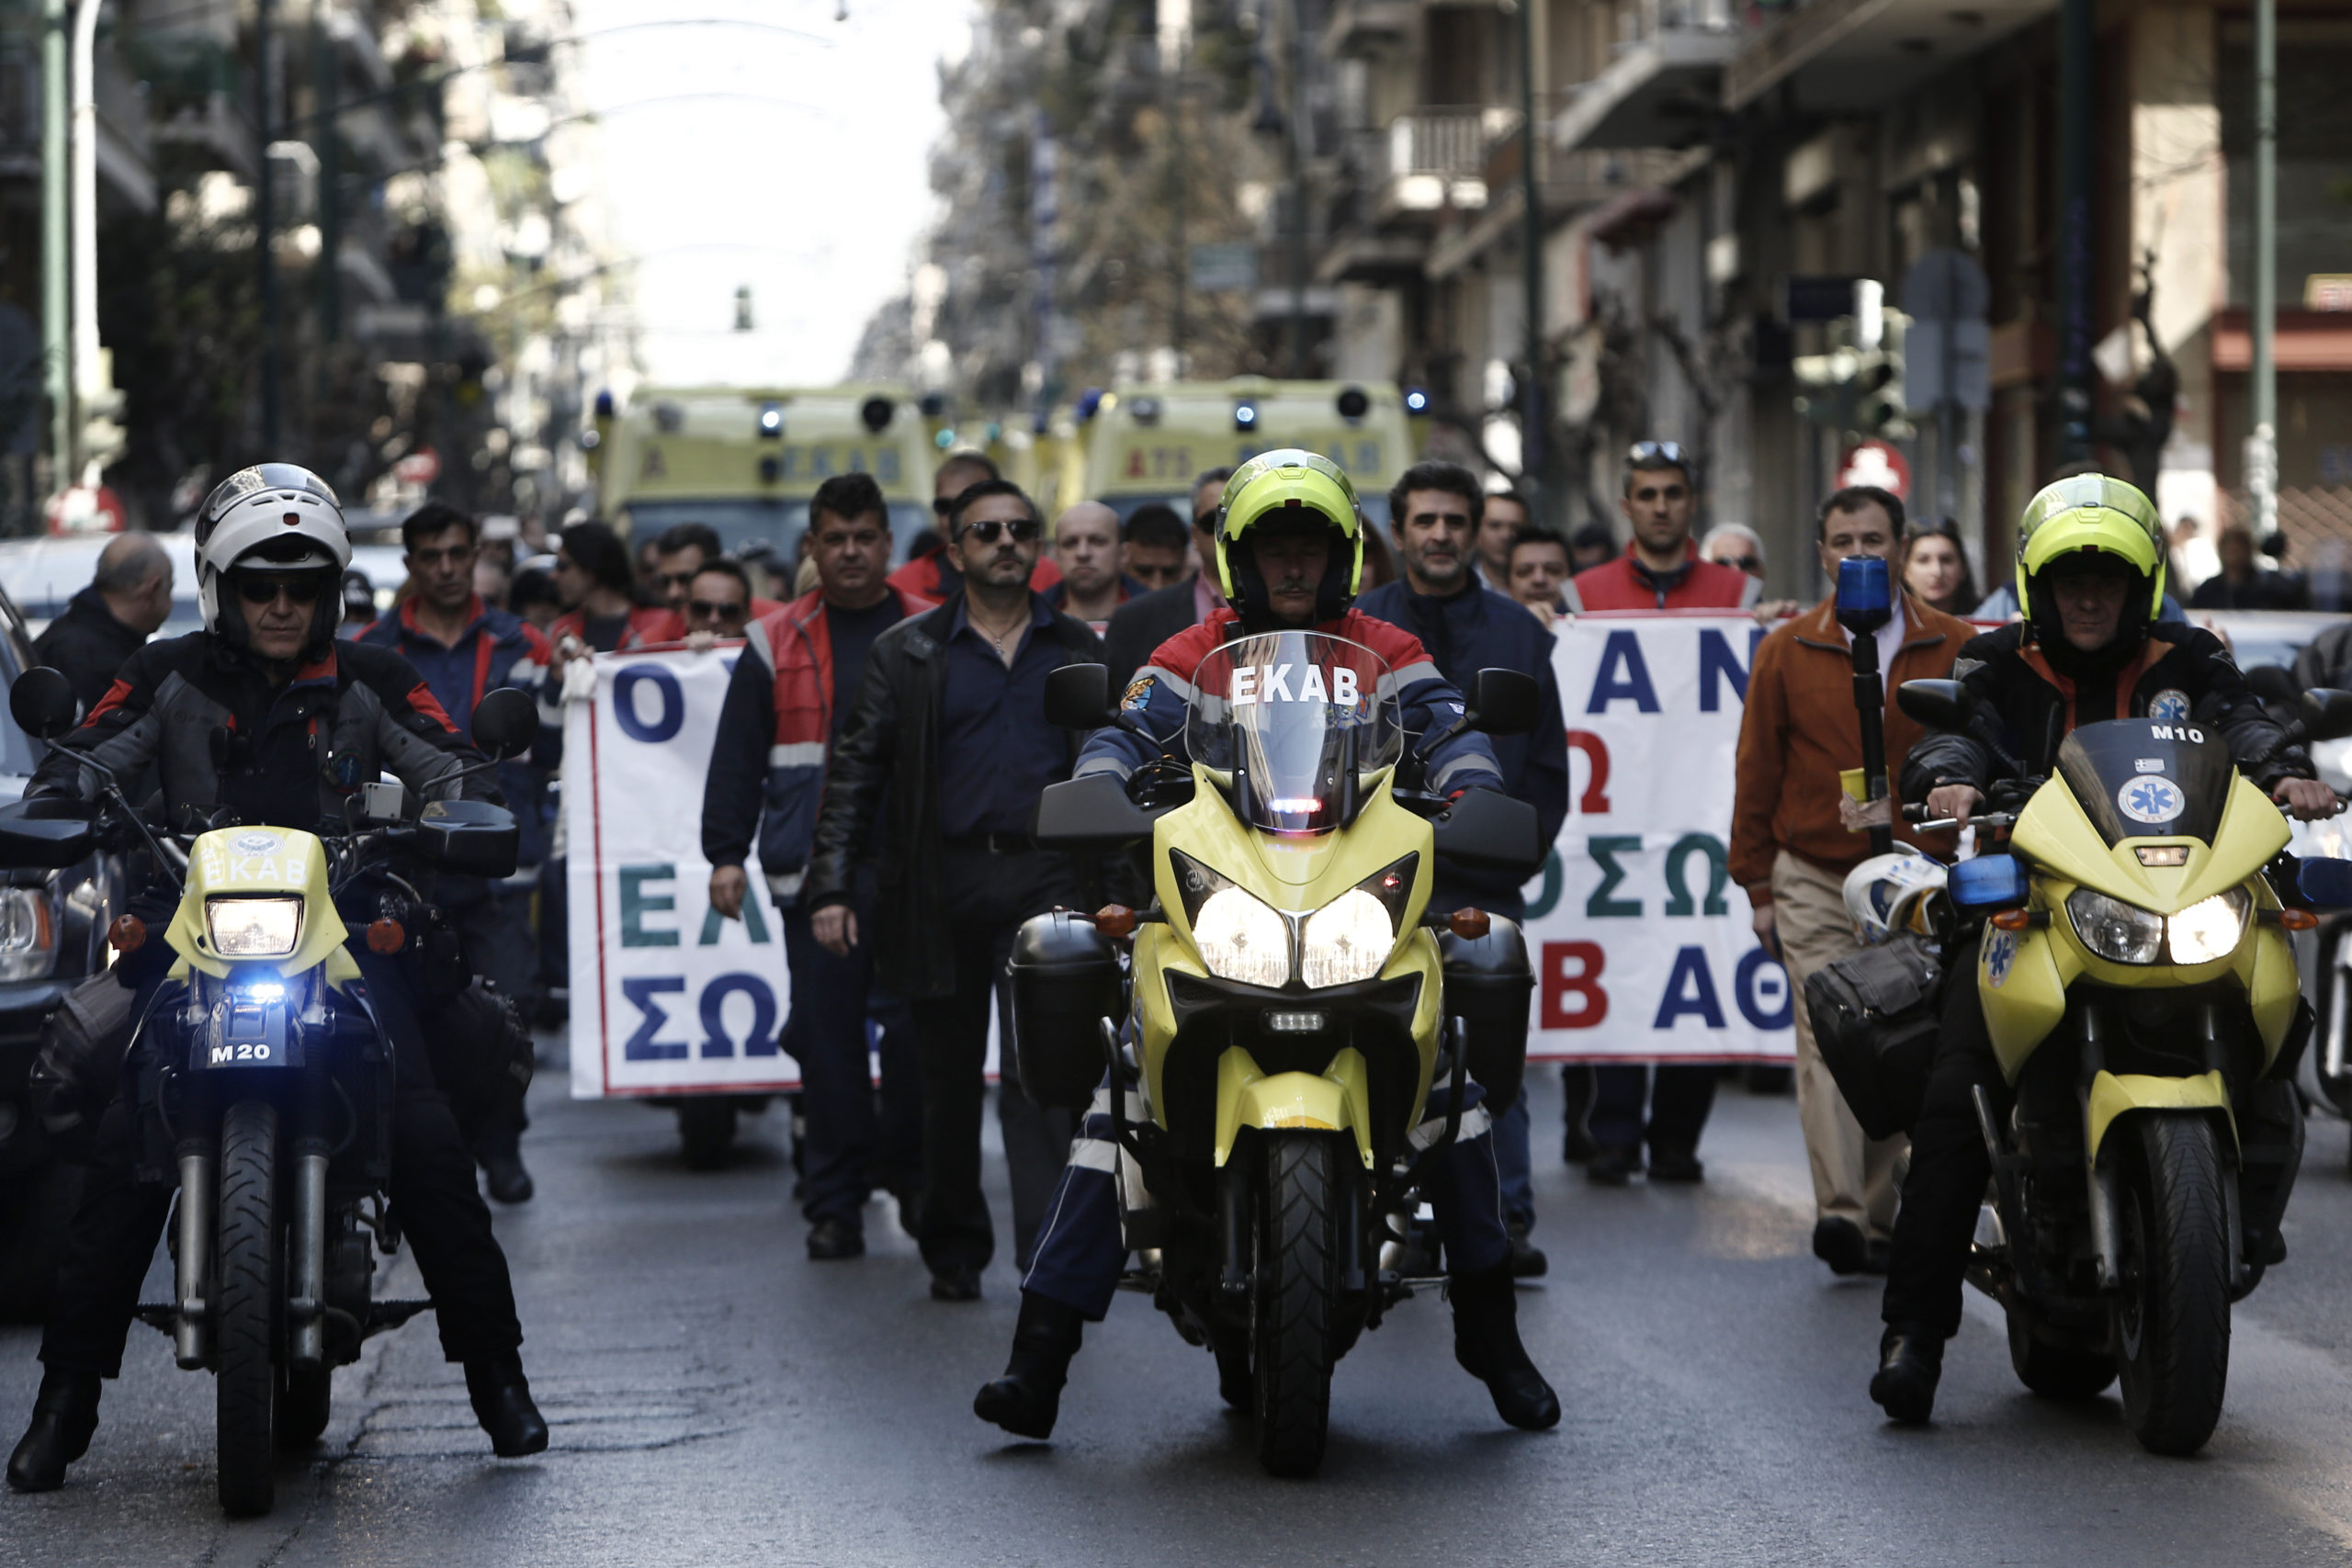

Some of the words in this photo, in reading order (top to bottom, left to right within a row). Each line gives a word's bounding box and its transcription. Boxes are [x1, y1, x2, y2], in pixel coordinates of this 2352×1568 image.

[1232, 663, 1359, 707] ΕΚΑΒ
[2151, 725, 2205, 744] M10
[205, 856, 307, 887] ΕΚΑΒ
